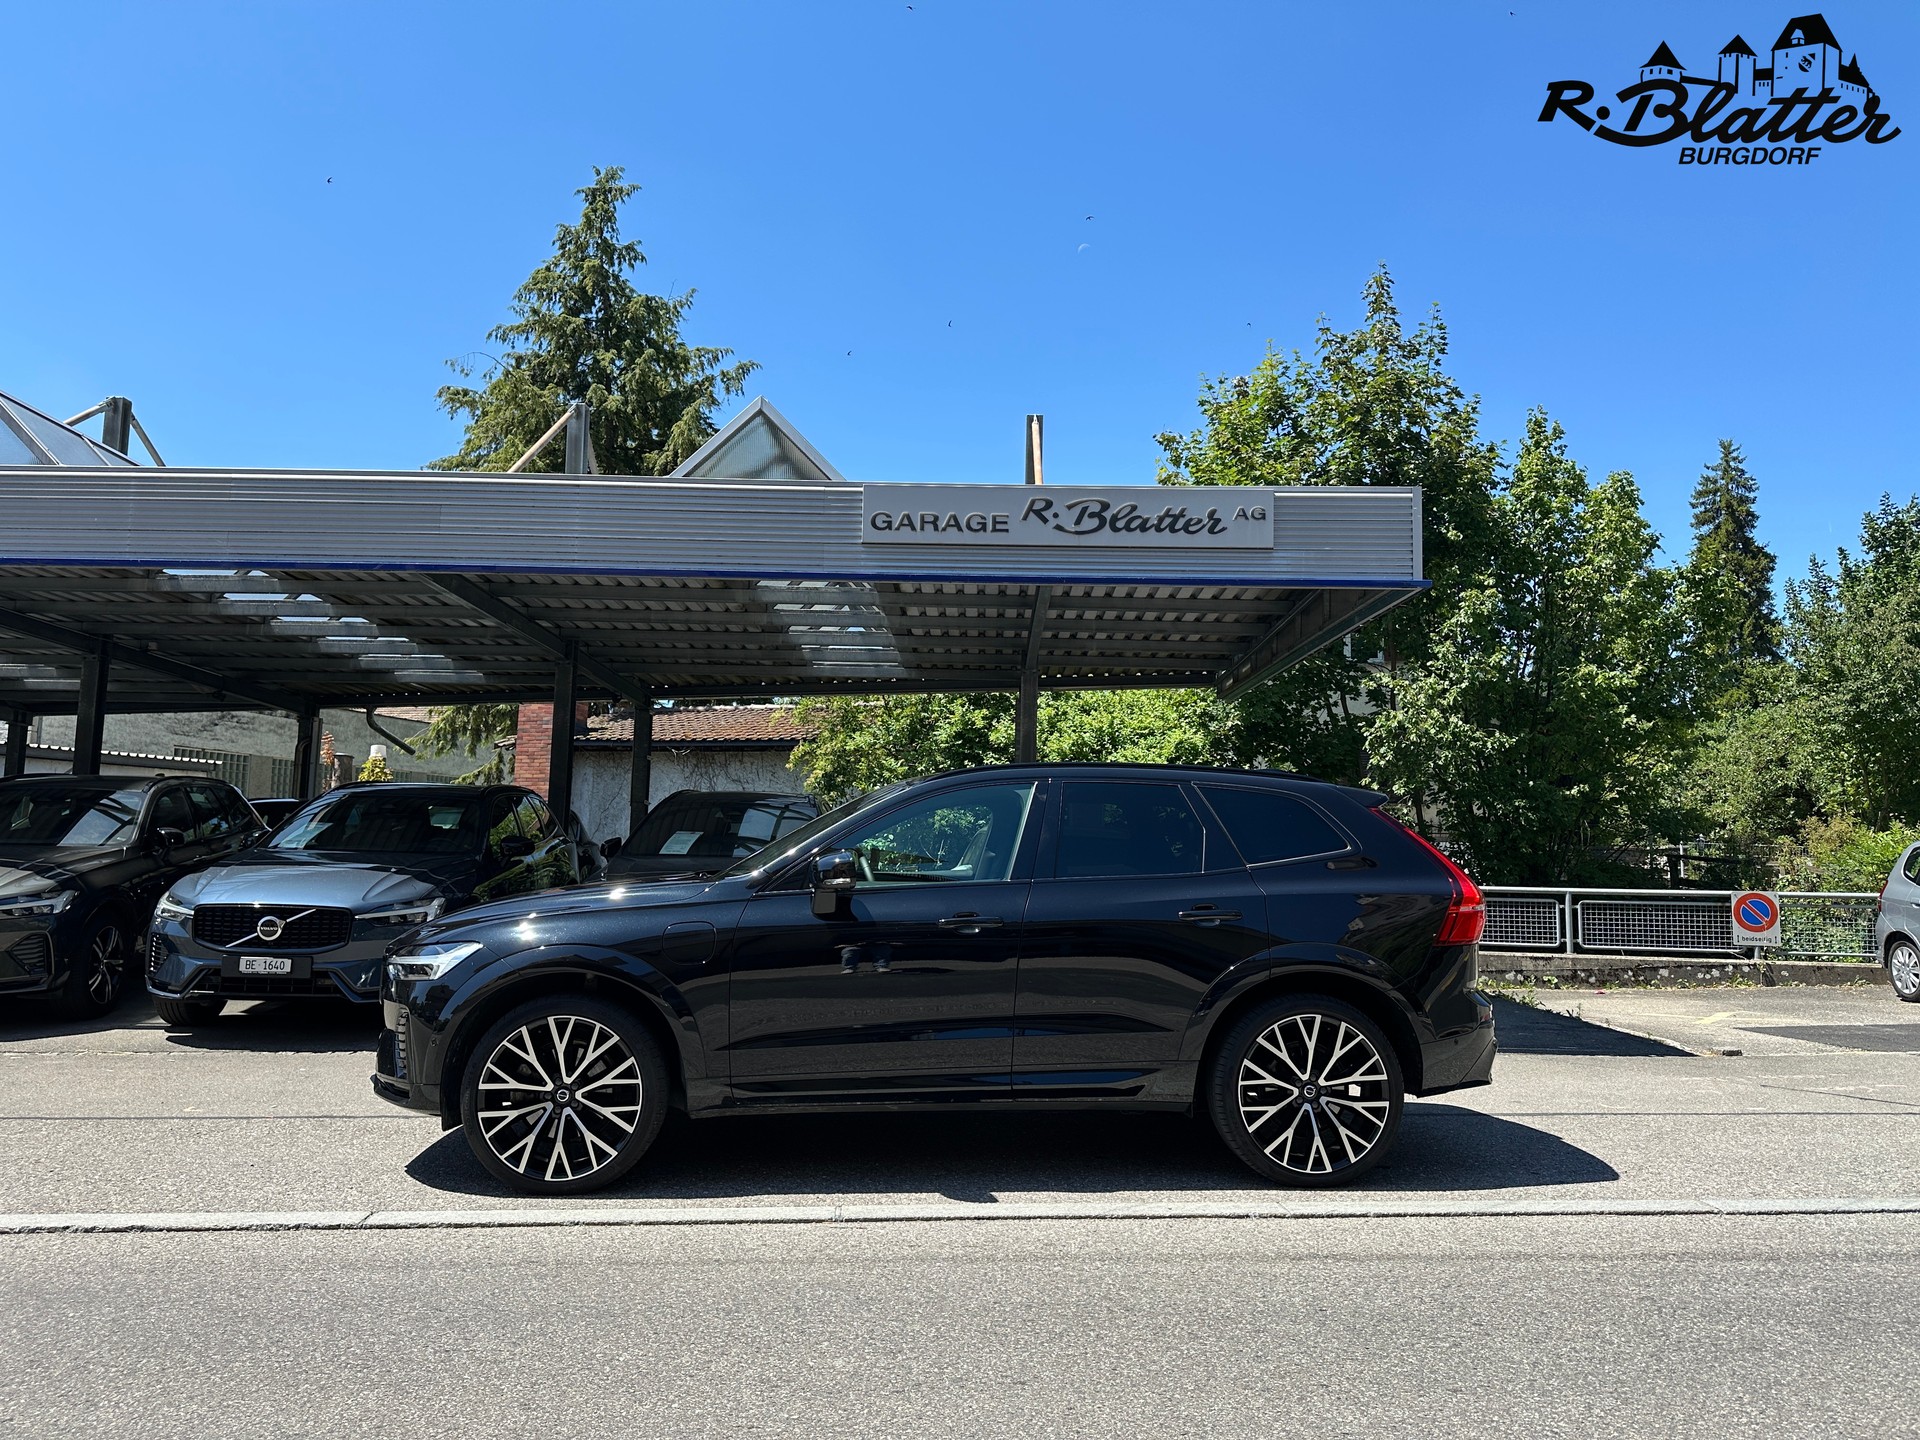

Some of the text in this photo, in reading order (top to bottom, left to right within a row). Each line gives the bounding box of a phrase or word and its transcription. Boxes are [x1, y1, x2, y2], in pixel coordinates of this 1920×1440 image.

[870, 511, 1010, 534] GARAGE
[1232, 505, 1267, 522] AG
[245, 960, 285, 970] BE 1640
